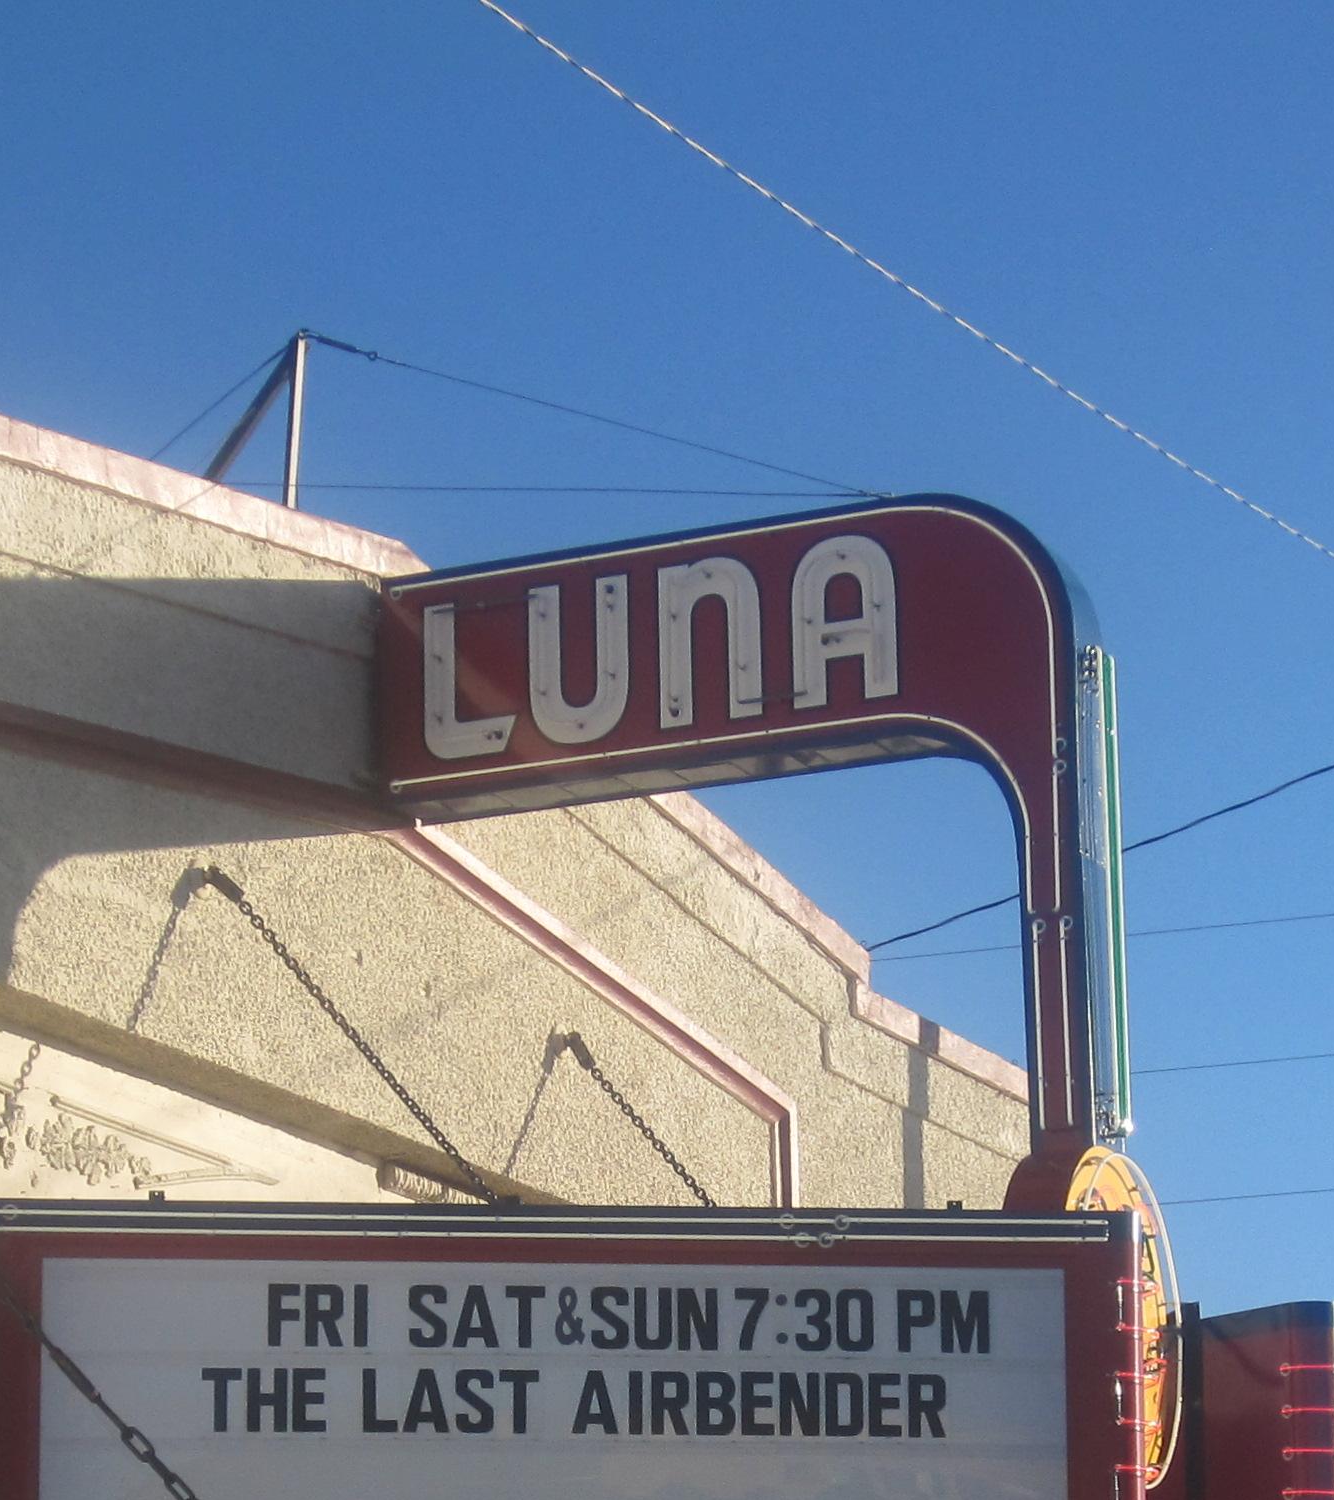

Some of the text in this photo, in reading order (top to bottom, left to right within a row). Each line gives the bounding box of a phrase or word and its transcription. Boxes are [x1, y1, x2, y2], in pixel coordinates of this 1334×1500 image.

[423, 534, 899, 759] LUNA
[267, 1283, 369, 1348] FRI
[733, 1286, 875, 1353] 7:30
[896, 1288, 992, 1355] PM
[201, 1367, 947, 1439] THE LAST AIRBENDER
